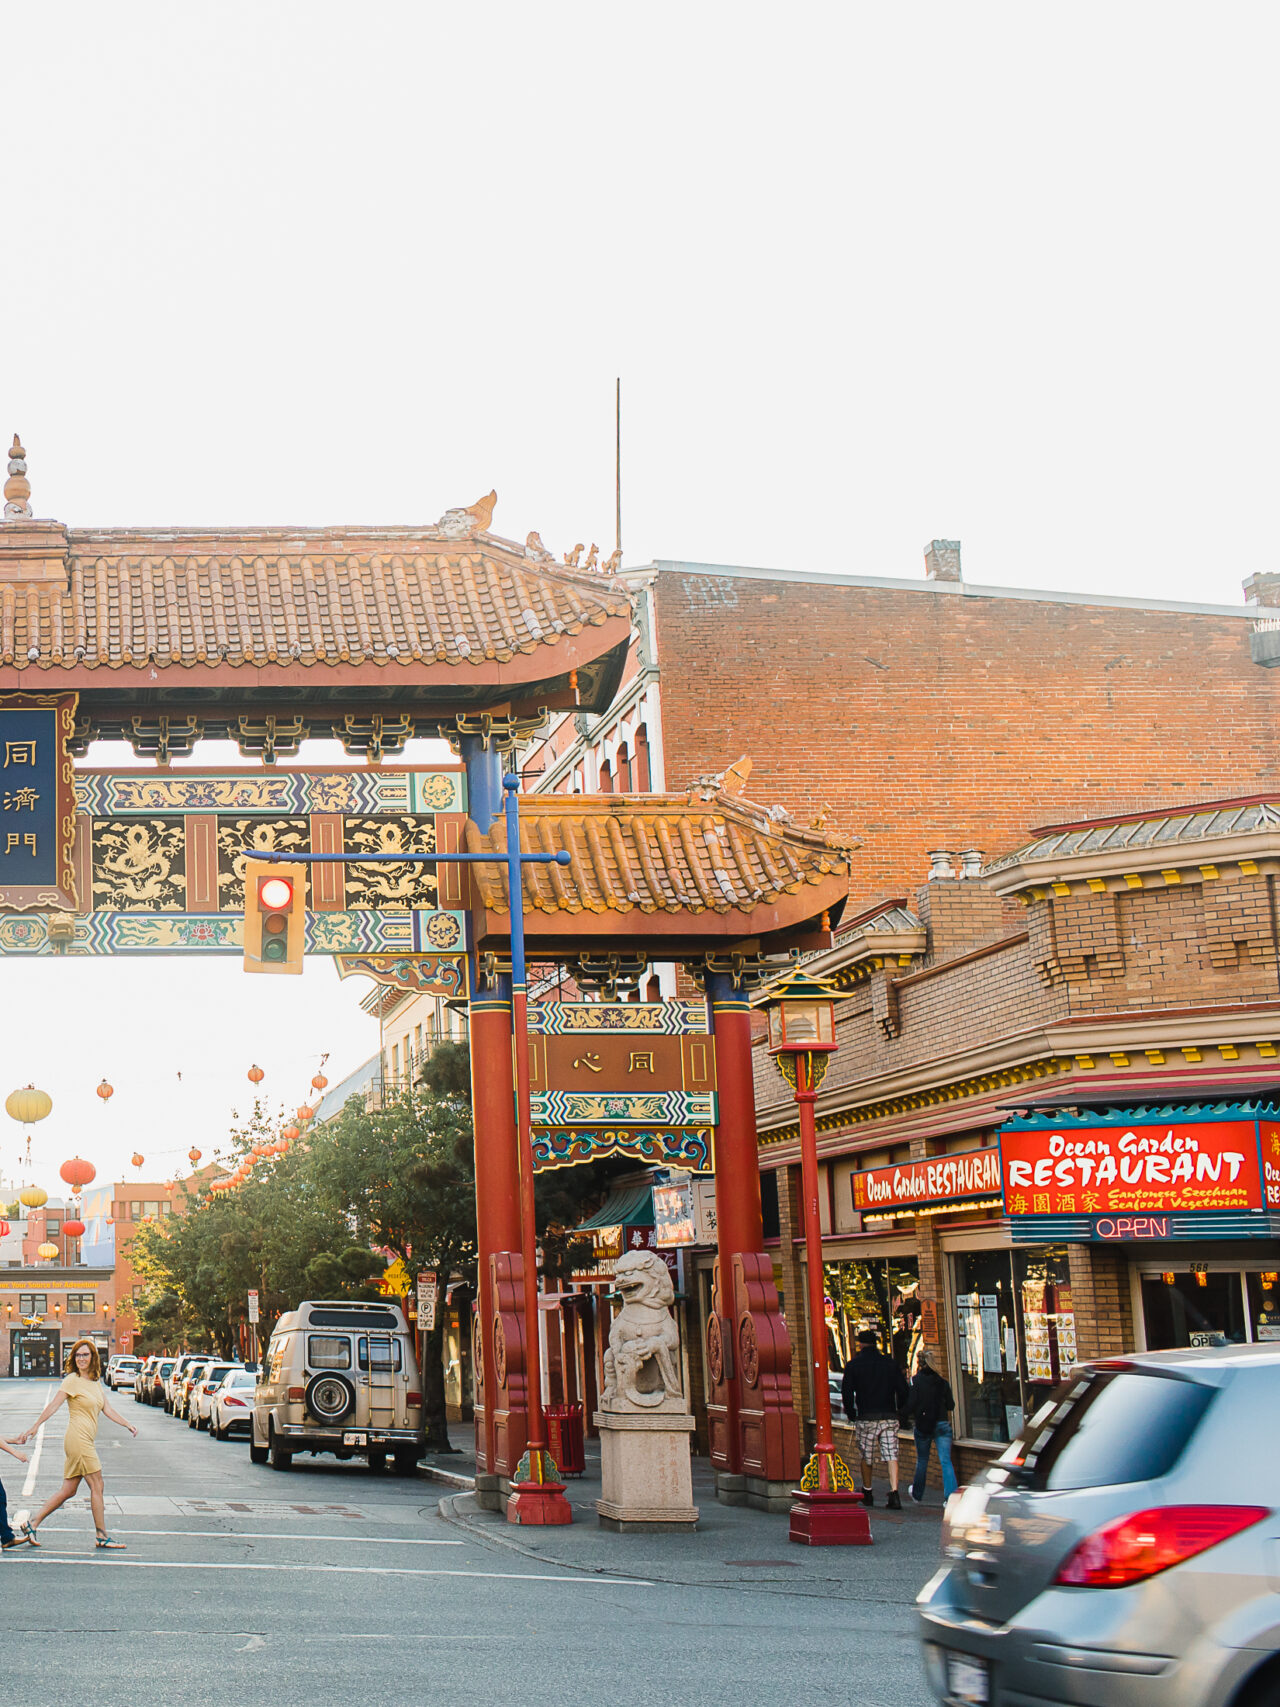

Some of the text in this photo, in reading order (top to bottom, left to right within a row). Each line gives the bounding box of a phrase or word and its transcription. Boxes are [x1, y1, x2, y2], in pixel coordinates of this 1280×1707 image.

[3, 740, 40, 857] 同濟門
[1049, 1130, 1199, 1157] Ocean Garden
[867, 1154, 1001, 1202] Ocean Garden RESTAURAN
[1008, 1152, 1245, 1187] RESTAURANT
[1008, 1190, 1102, 1215] 海園酒家
[1107, 1186, 1248, 1199] Cantonese Szechuan
[1108, 1197, 1249, 1211] Seafood Vegetarian
[1096, 1217, 1167, 1238] OPEN
[1189, 1262, 1209, 1273] 568
